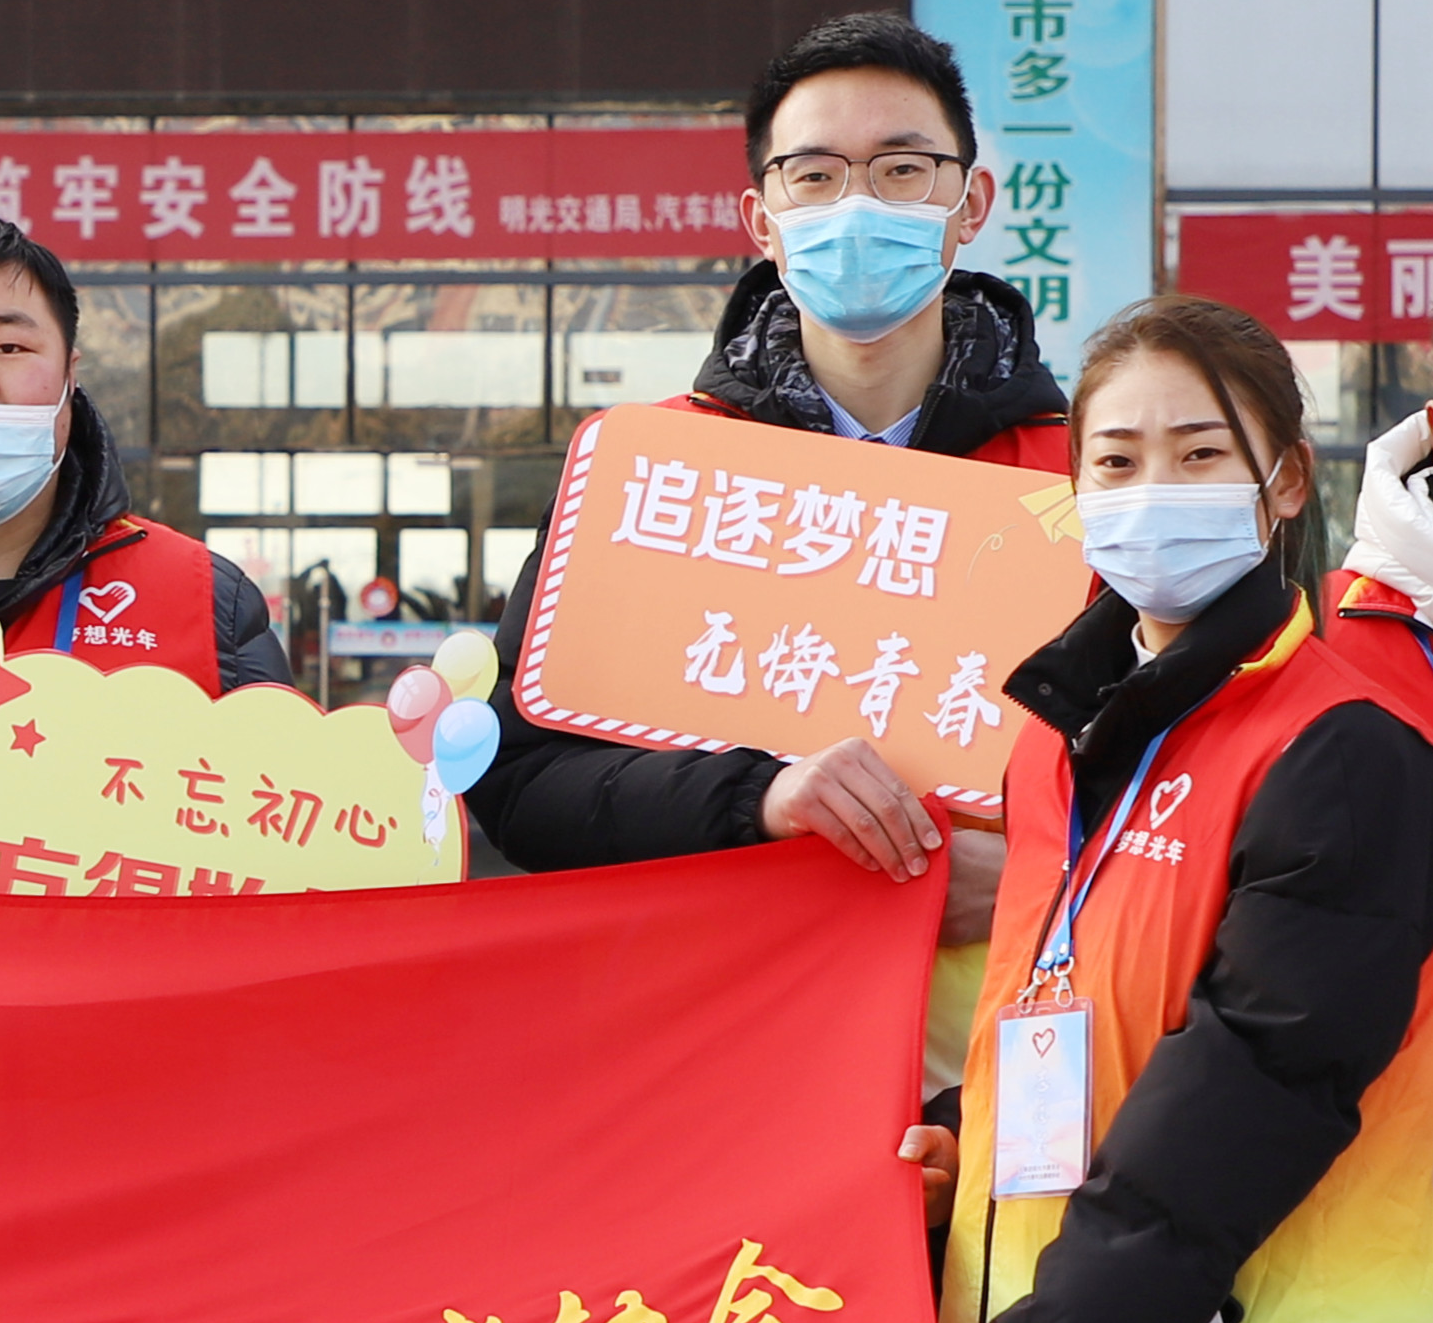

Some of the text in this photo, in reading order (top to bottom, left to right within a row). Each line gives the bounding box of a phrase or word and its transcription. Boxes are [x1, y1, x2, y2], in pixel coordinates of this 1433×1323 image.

[610, 455, 951, 599] 追逐梦想
[682, 610, 1002, 749] 无悔青春
[99, 756, 399, 850] 不忘初心
